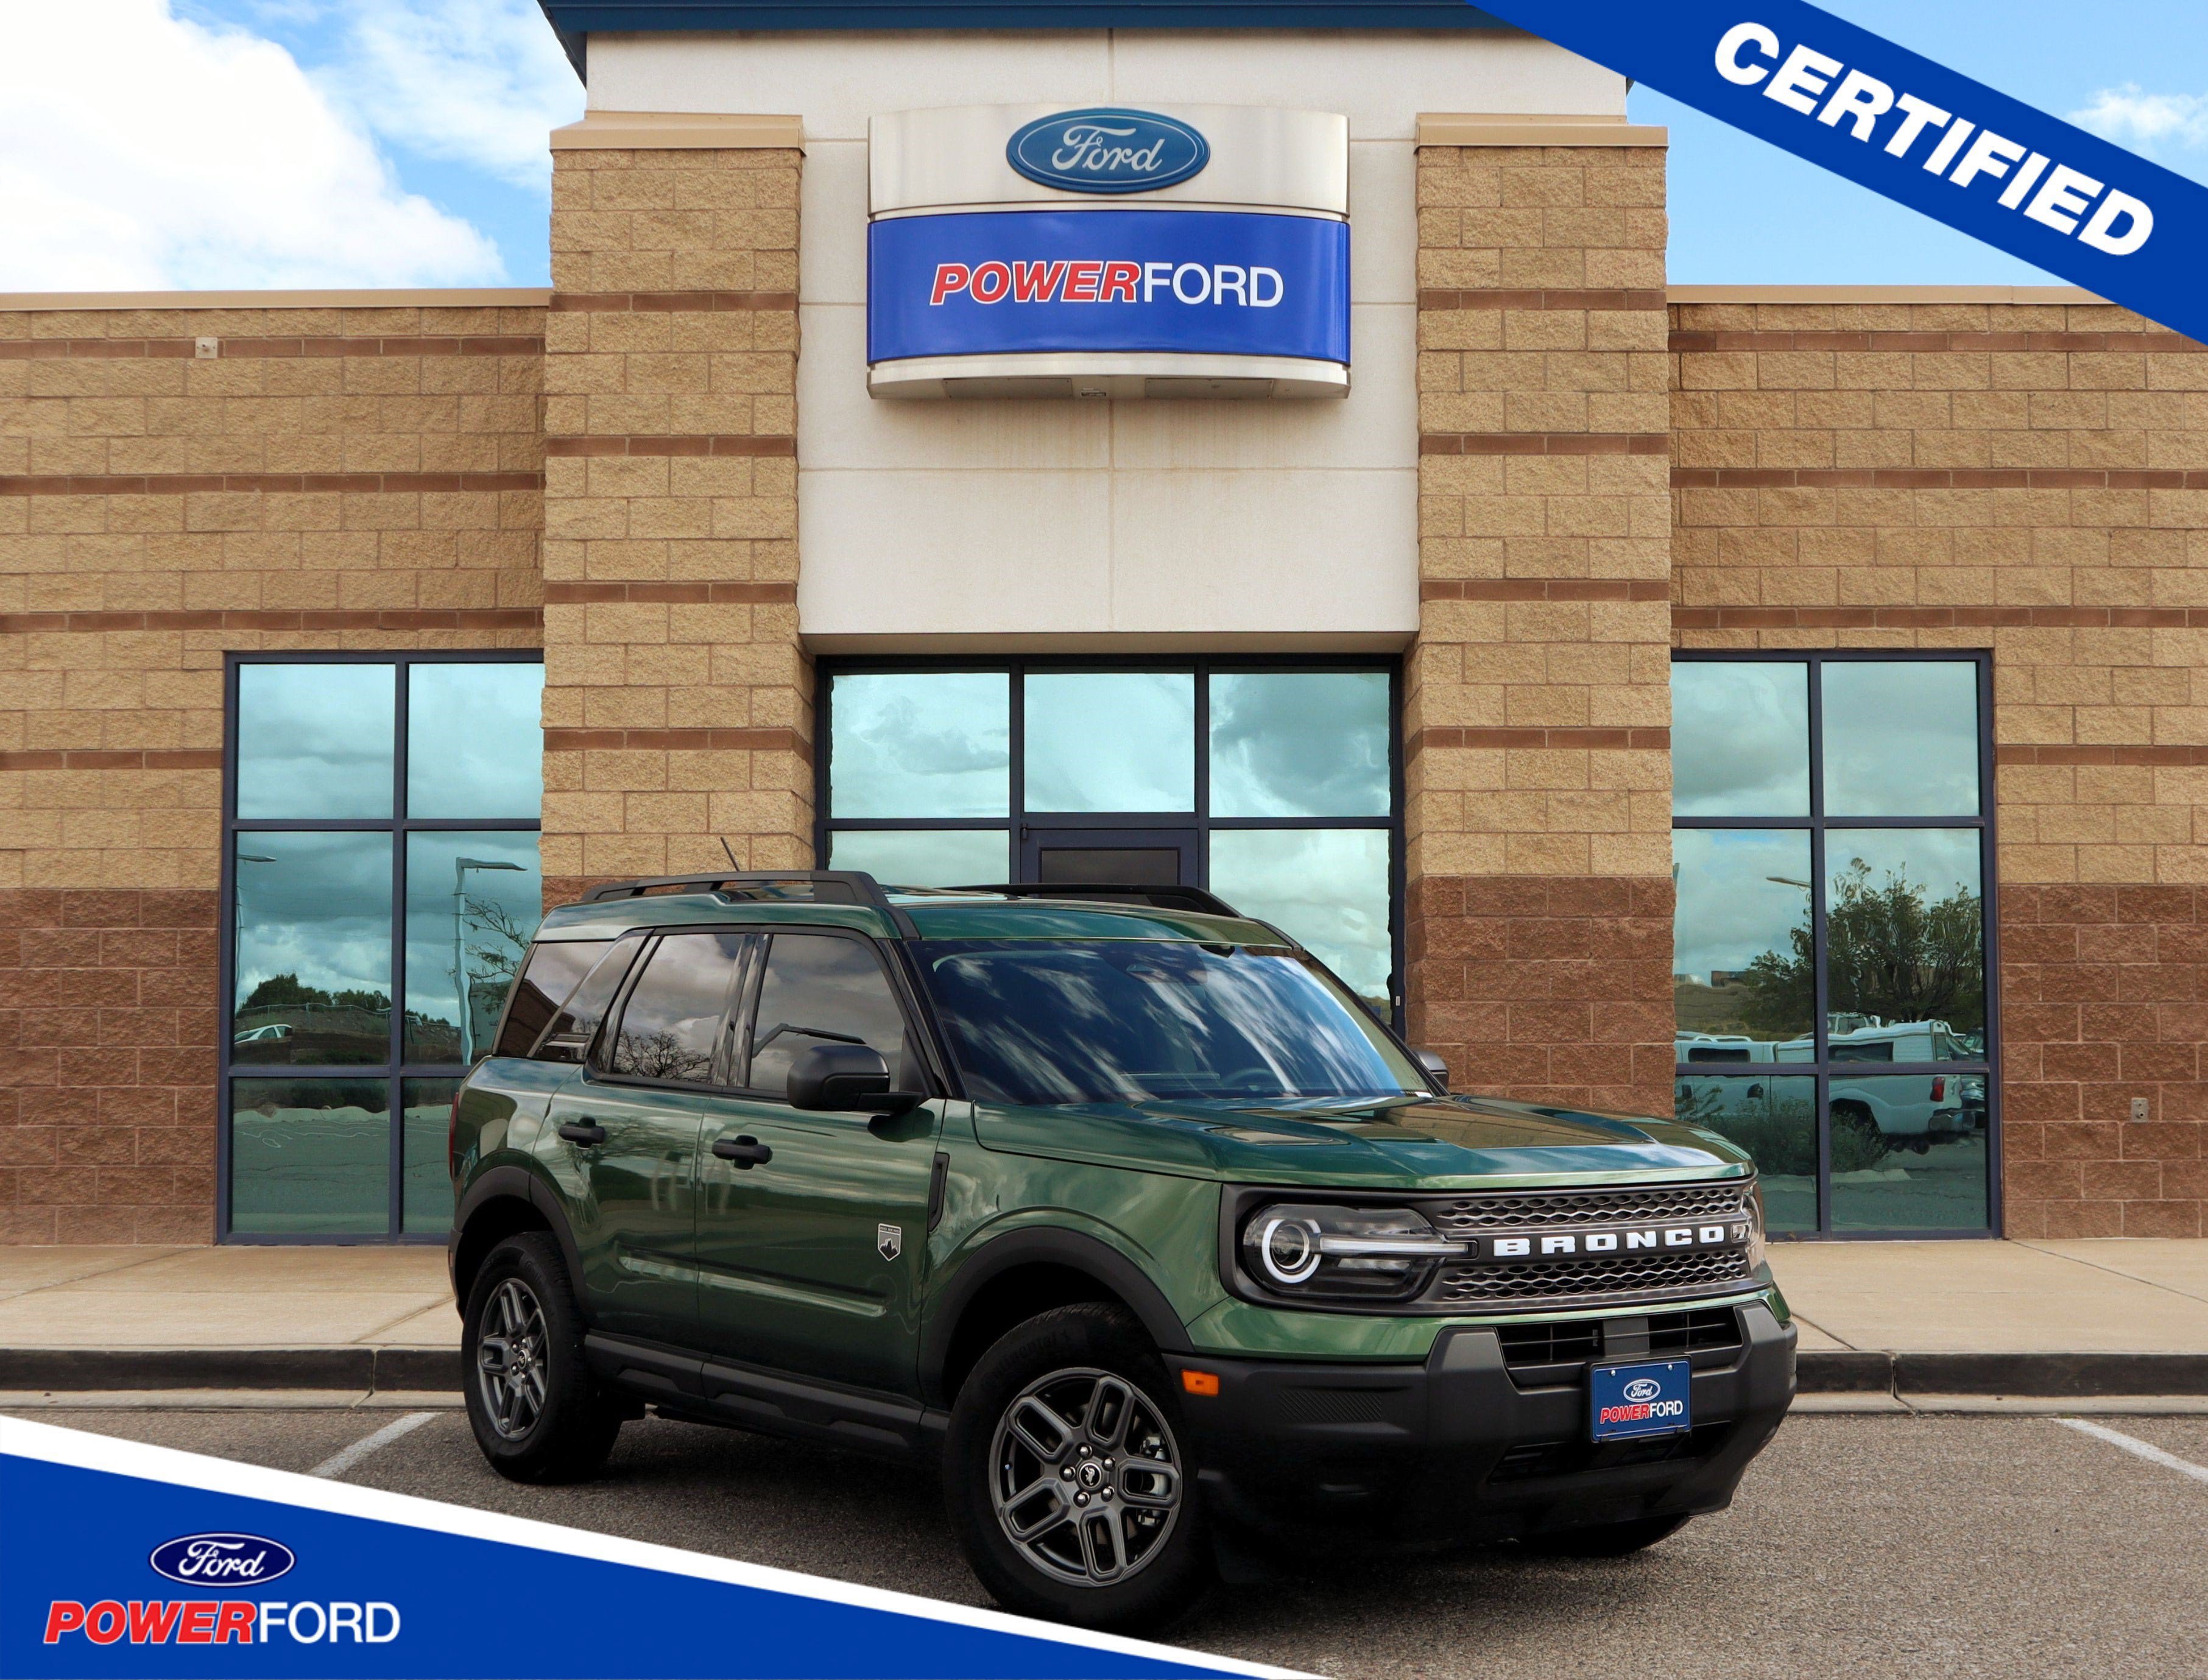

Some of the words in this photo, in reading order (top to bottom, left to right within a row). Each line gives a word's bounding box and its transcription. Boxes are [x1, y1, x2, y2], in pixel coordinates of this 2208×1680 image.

[1051, 124, 1165, 172] Ford
[1493, 1226, 1725, 1257] BRONCO
[1631, 1383, 1653, 1397] Ford
